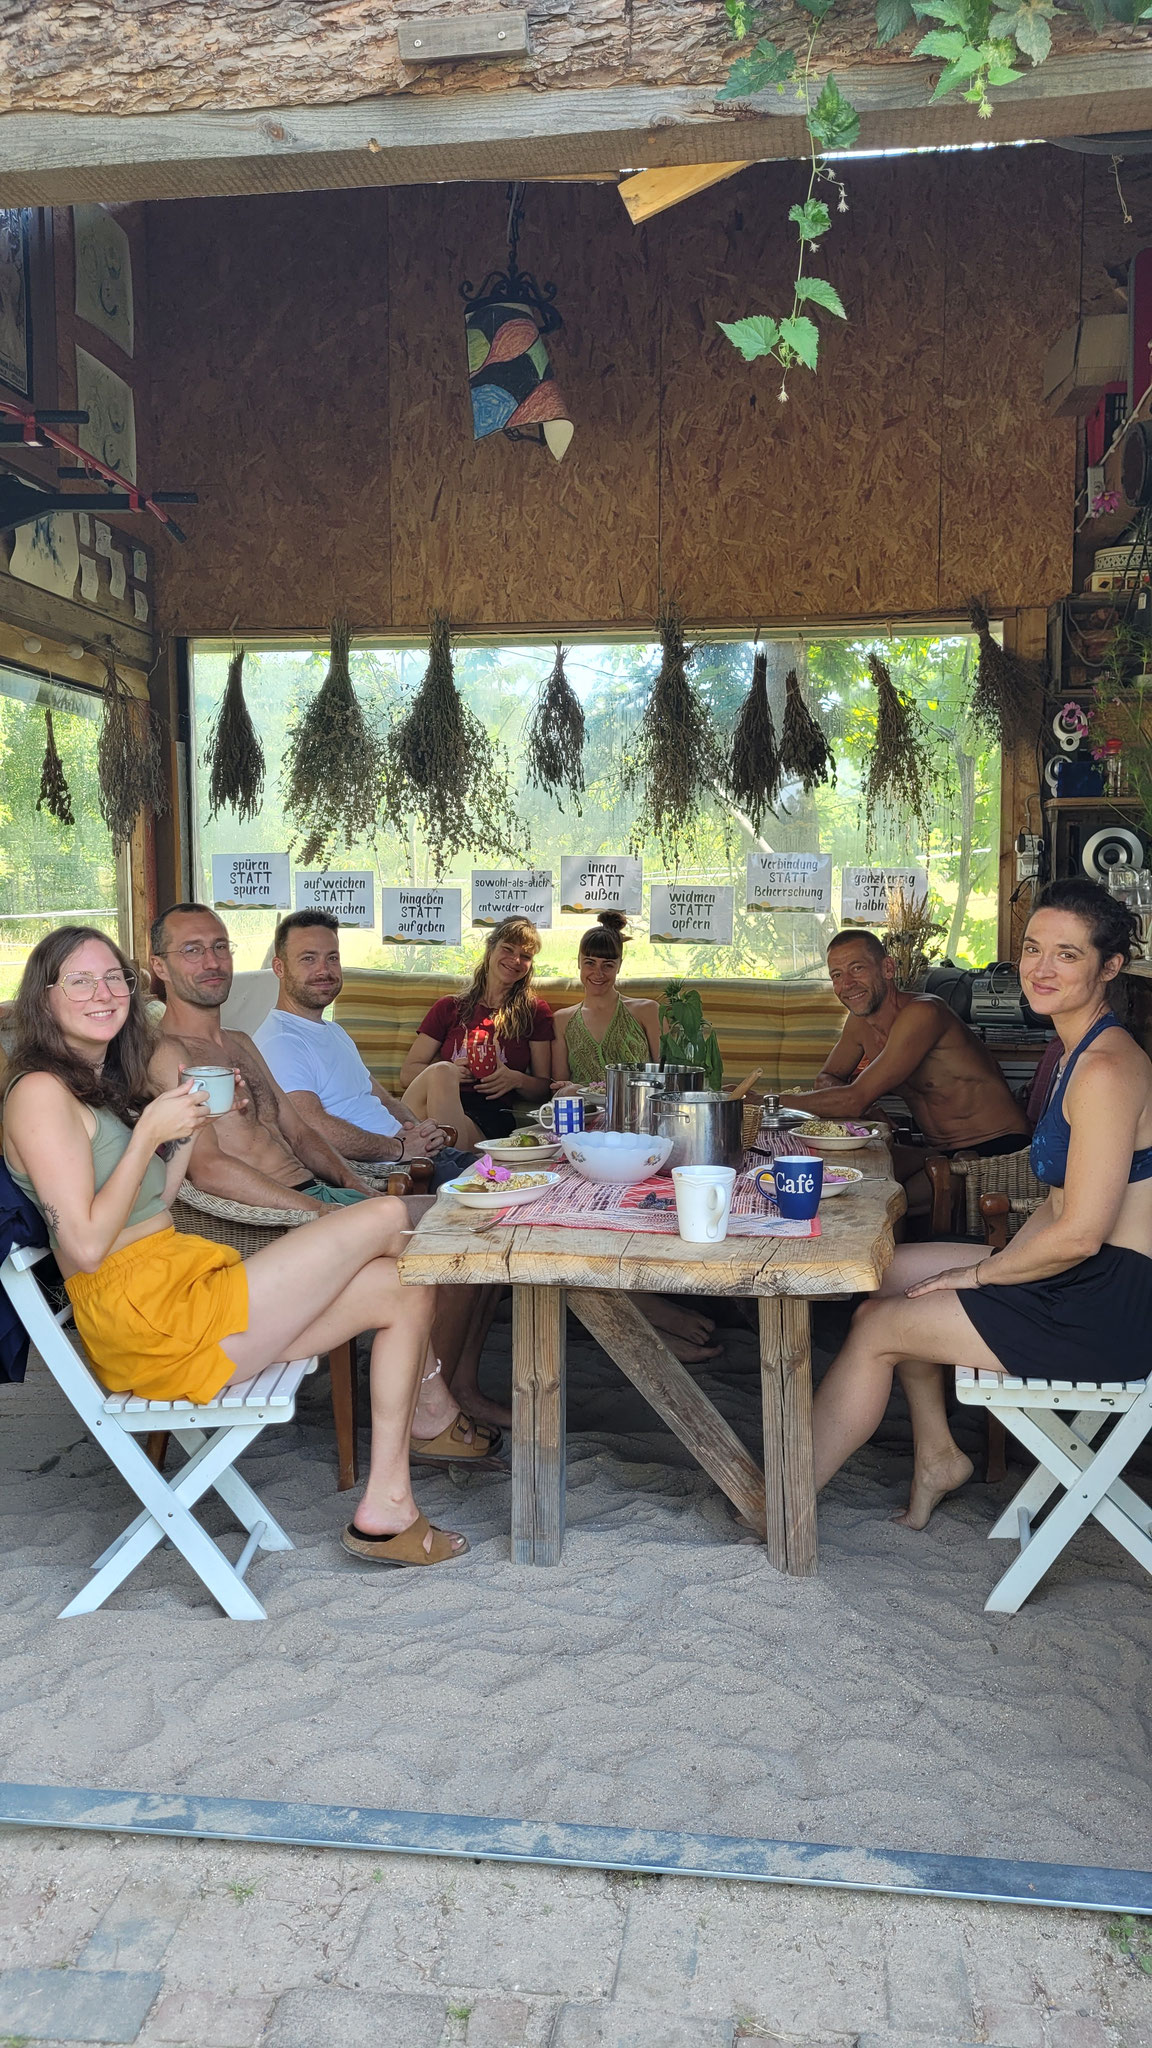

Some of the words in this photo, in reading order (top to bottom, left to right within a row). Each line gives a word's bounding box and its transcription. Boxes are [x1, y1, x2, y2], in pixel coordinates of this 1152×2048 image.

[233, 859, 269, 872] spüren
[588, 860, 617, 873] innen
[760, 858, 819, 872] Verbindung
[230, 872, 272, 884] STATT
[303, 877, 366, 889] aufweichen
[475, 877, 548, 888] sowohl-als-auch
[580, 874, 624, 887] STATT
[769, 872, 808, 883] STATT
[234, 886, 270, 899] spuren
[314, 890, 355, 901] STATT
[495, 890, 528, 899] STATT
[585, 888, 620, 901] außen
[669, 890, 716, 903] widmen
[754, 886, 823, 900] Beherrschung
[863, 885, 905, 897] STAT
[400, 892, 444, 907] hingeben
[401, 906, 442, 918] STATT
[479, 902, 544, 912] entweder-oder
[670, 903, 714, 916] STATT
[398, 920, 445, 935] aufgeben
[672, 917, 710, 932] opfern
[776, 1172, 815, 1194] Café
